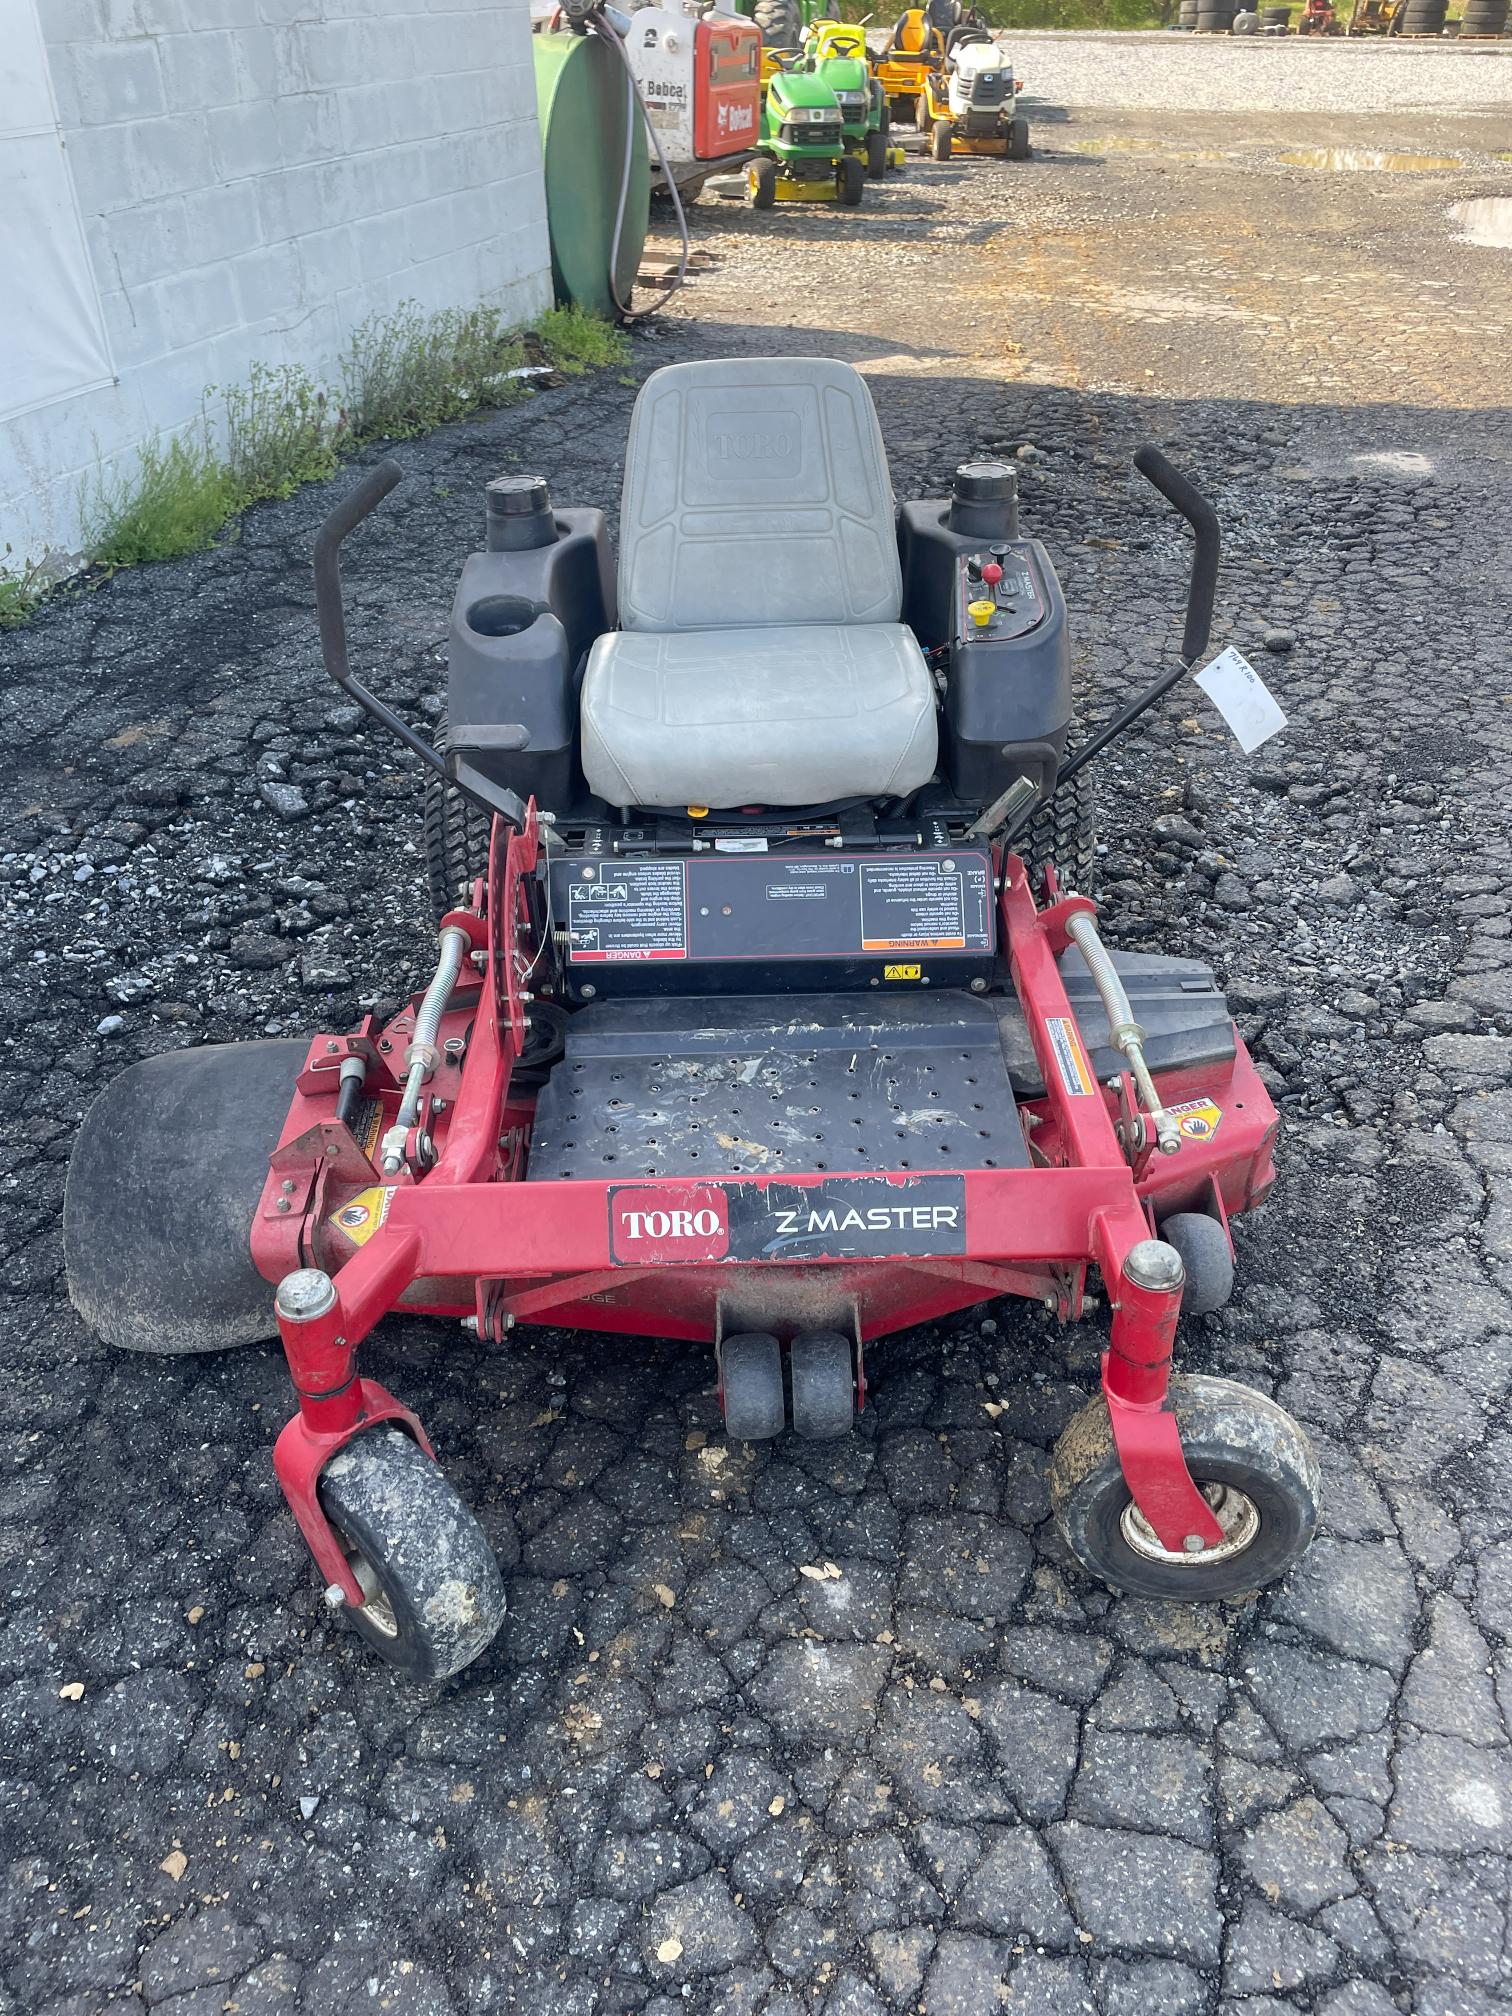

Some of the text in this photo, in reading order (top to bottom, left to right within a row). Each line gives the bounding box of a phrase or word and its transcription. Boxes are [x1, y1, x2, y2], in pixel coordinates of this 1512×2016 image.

[642, 28, 658, 48] 2
[367, 1118, 382, 1150] WARNING
[621, 1206, 958, 1239] TORO Z MASTER
